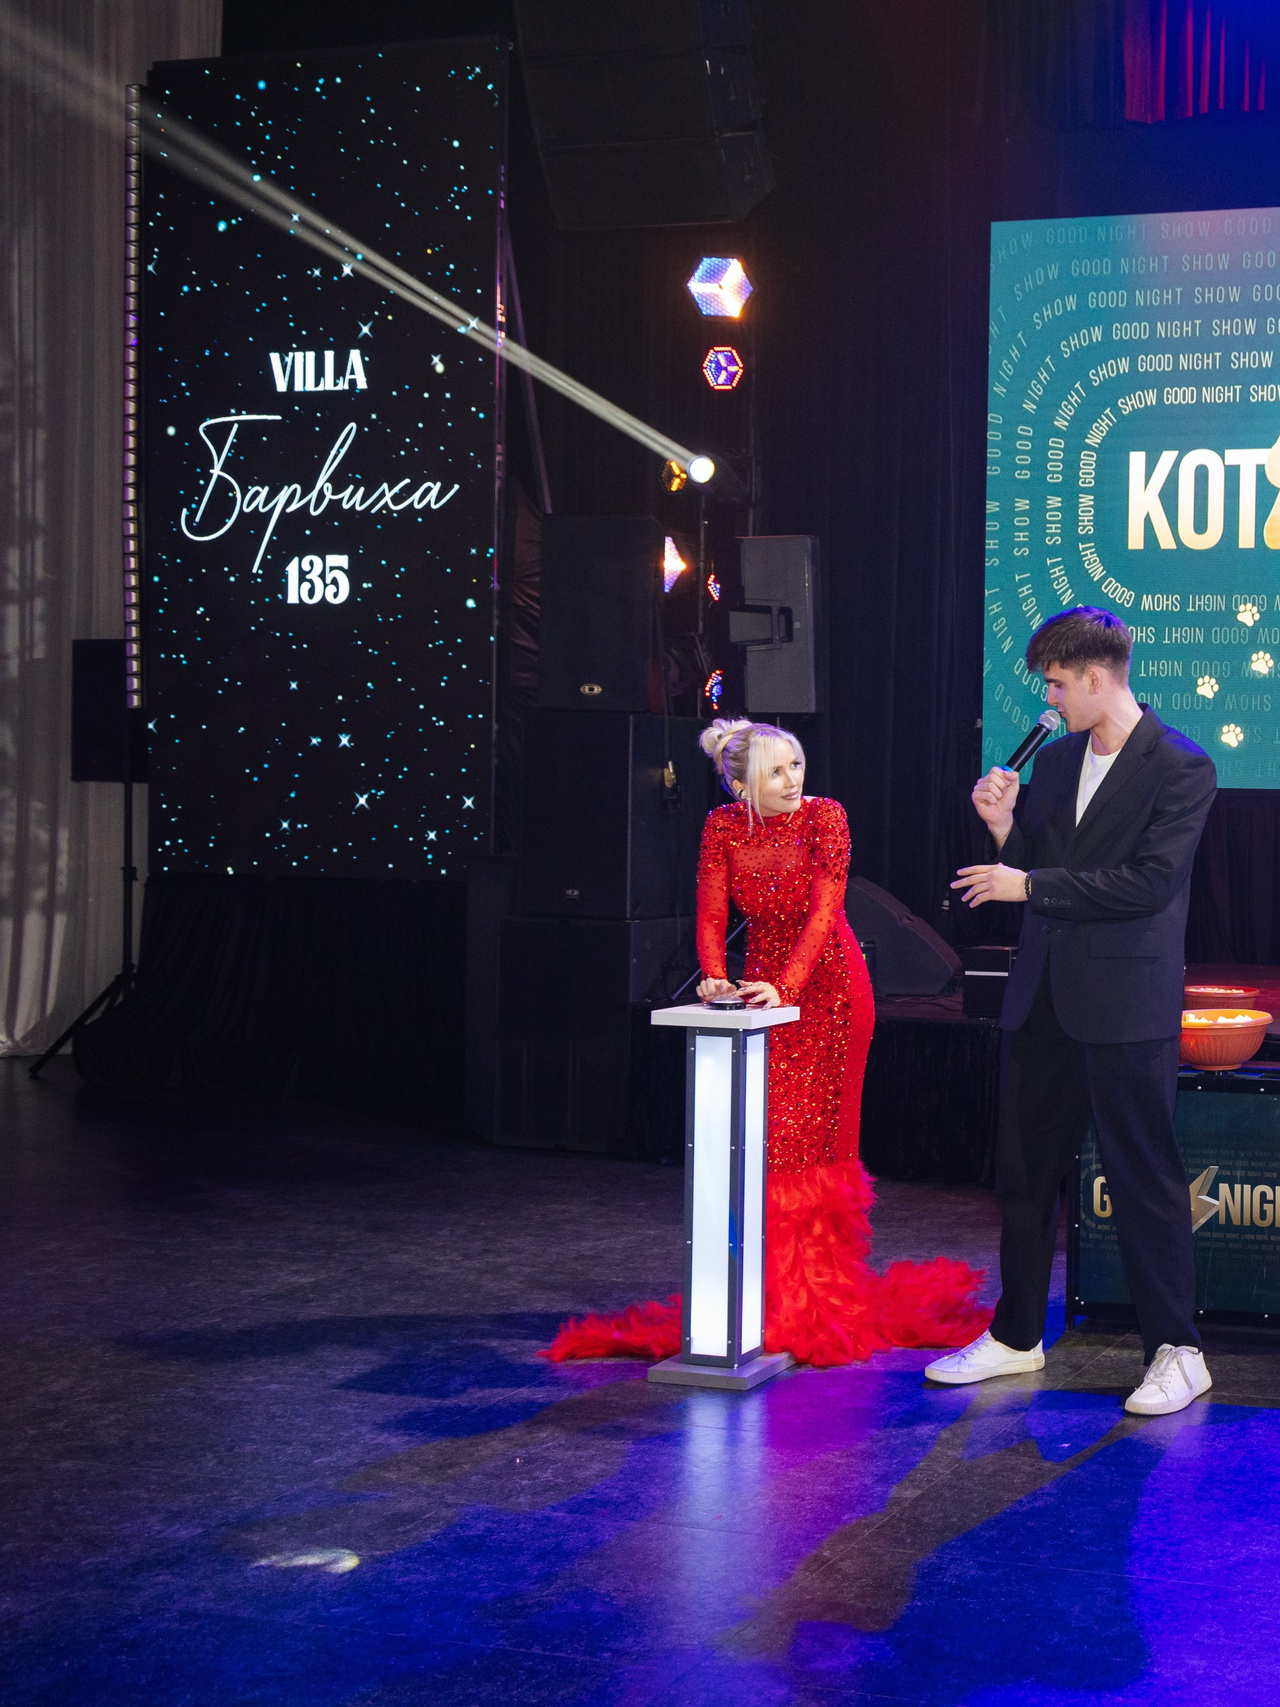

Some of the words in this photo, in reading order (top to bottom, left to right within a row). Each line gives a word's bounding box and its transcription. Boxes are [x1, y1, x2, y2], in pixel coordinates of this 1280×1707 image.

[1182, 253, 1229, 272] SHOW
[993, 331, 1027, 397] NIGHT
[1033, 294, 1077, 330] SHOW
[1088, 290, 1127, 308] GOOD
[1136, 288, 1182, 306] NIGHT
[1194, 286, 1241, 304] SHOW
[269, 349, 367, 392] VILLA
[1022, 355, 1055, 414] NIGHT
[1060, 325, 1102, 358] SHOW
[1112, 322, 1149, 340] GOOD
[1157, 320, 1201, 338] NIGHT
[1212, 318, 1256, 336] SHOW
[1054, 381, 1086, 430] NIGHT
[1089, 357, 1129, 386] SHOW
[1138, 354, 1173, 372] GOOD
[1179, 352, 1221, 370] NIGHT
[1231, 351, 1273, 369] SHOW
[1085, 408, 1116, 447] NIGHT
[1118, 389, 1157, 415] SHOW
[1164, 387, 1197, 405] GOOD
[1202, 385, 1242, 403] NIGHT
[986, 413, 1002, 475] GOOD
[1015, 425, 1033, 479] GOOD
[1047, 438, 1064, 483] GOOD
[1079, 451, 1097, 487] GOOD
[181, 415, 460, 573] Барвиха
[1078, 494, 1094, 535] SHOW
[985, 500, 1000, 567] SHOW
[1013, 498, 1029, 556] SHOW
[1045, 496, 1062, 545] SHOW
[285, 554, 350, 604] 135
[1047, 558, 1074, 605] NIGHT
[1079, 543, 1106, 581] NIGHT
[1015, 573, 1043, 630] NIGHT
[1101, 577, 1135, 607] GOOD
[1141, 594, 1180, 611] SHOW
[1187, 594, 1225, 611] NIGHT
[984, 588, 1014, 653] NIGHT
[1163, 627, 1204, 644] NIGHT
[1212, 627, 1248, 644] GOOD
[1139, 660, 1182, 677] NIGHT
[1191, 661, 1231, 679] GOOD
